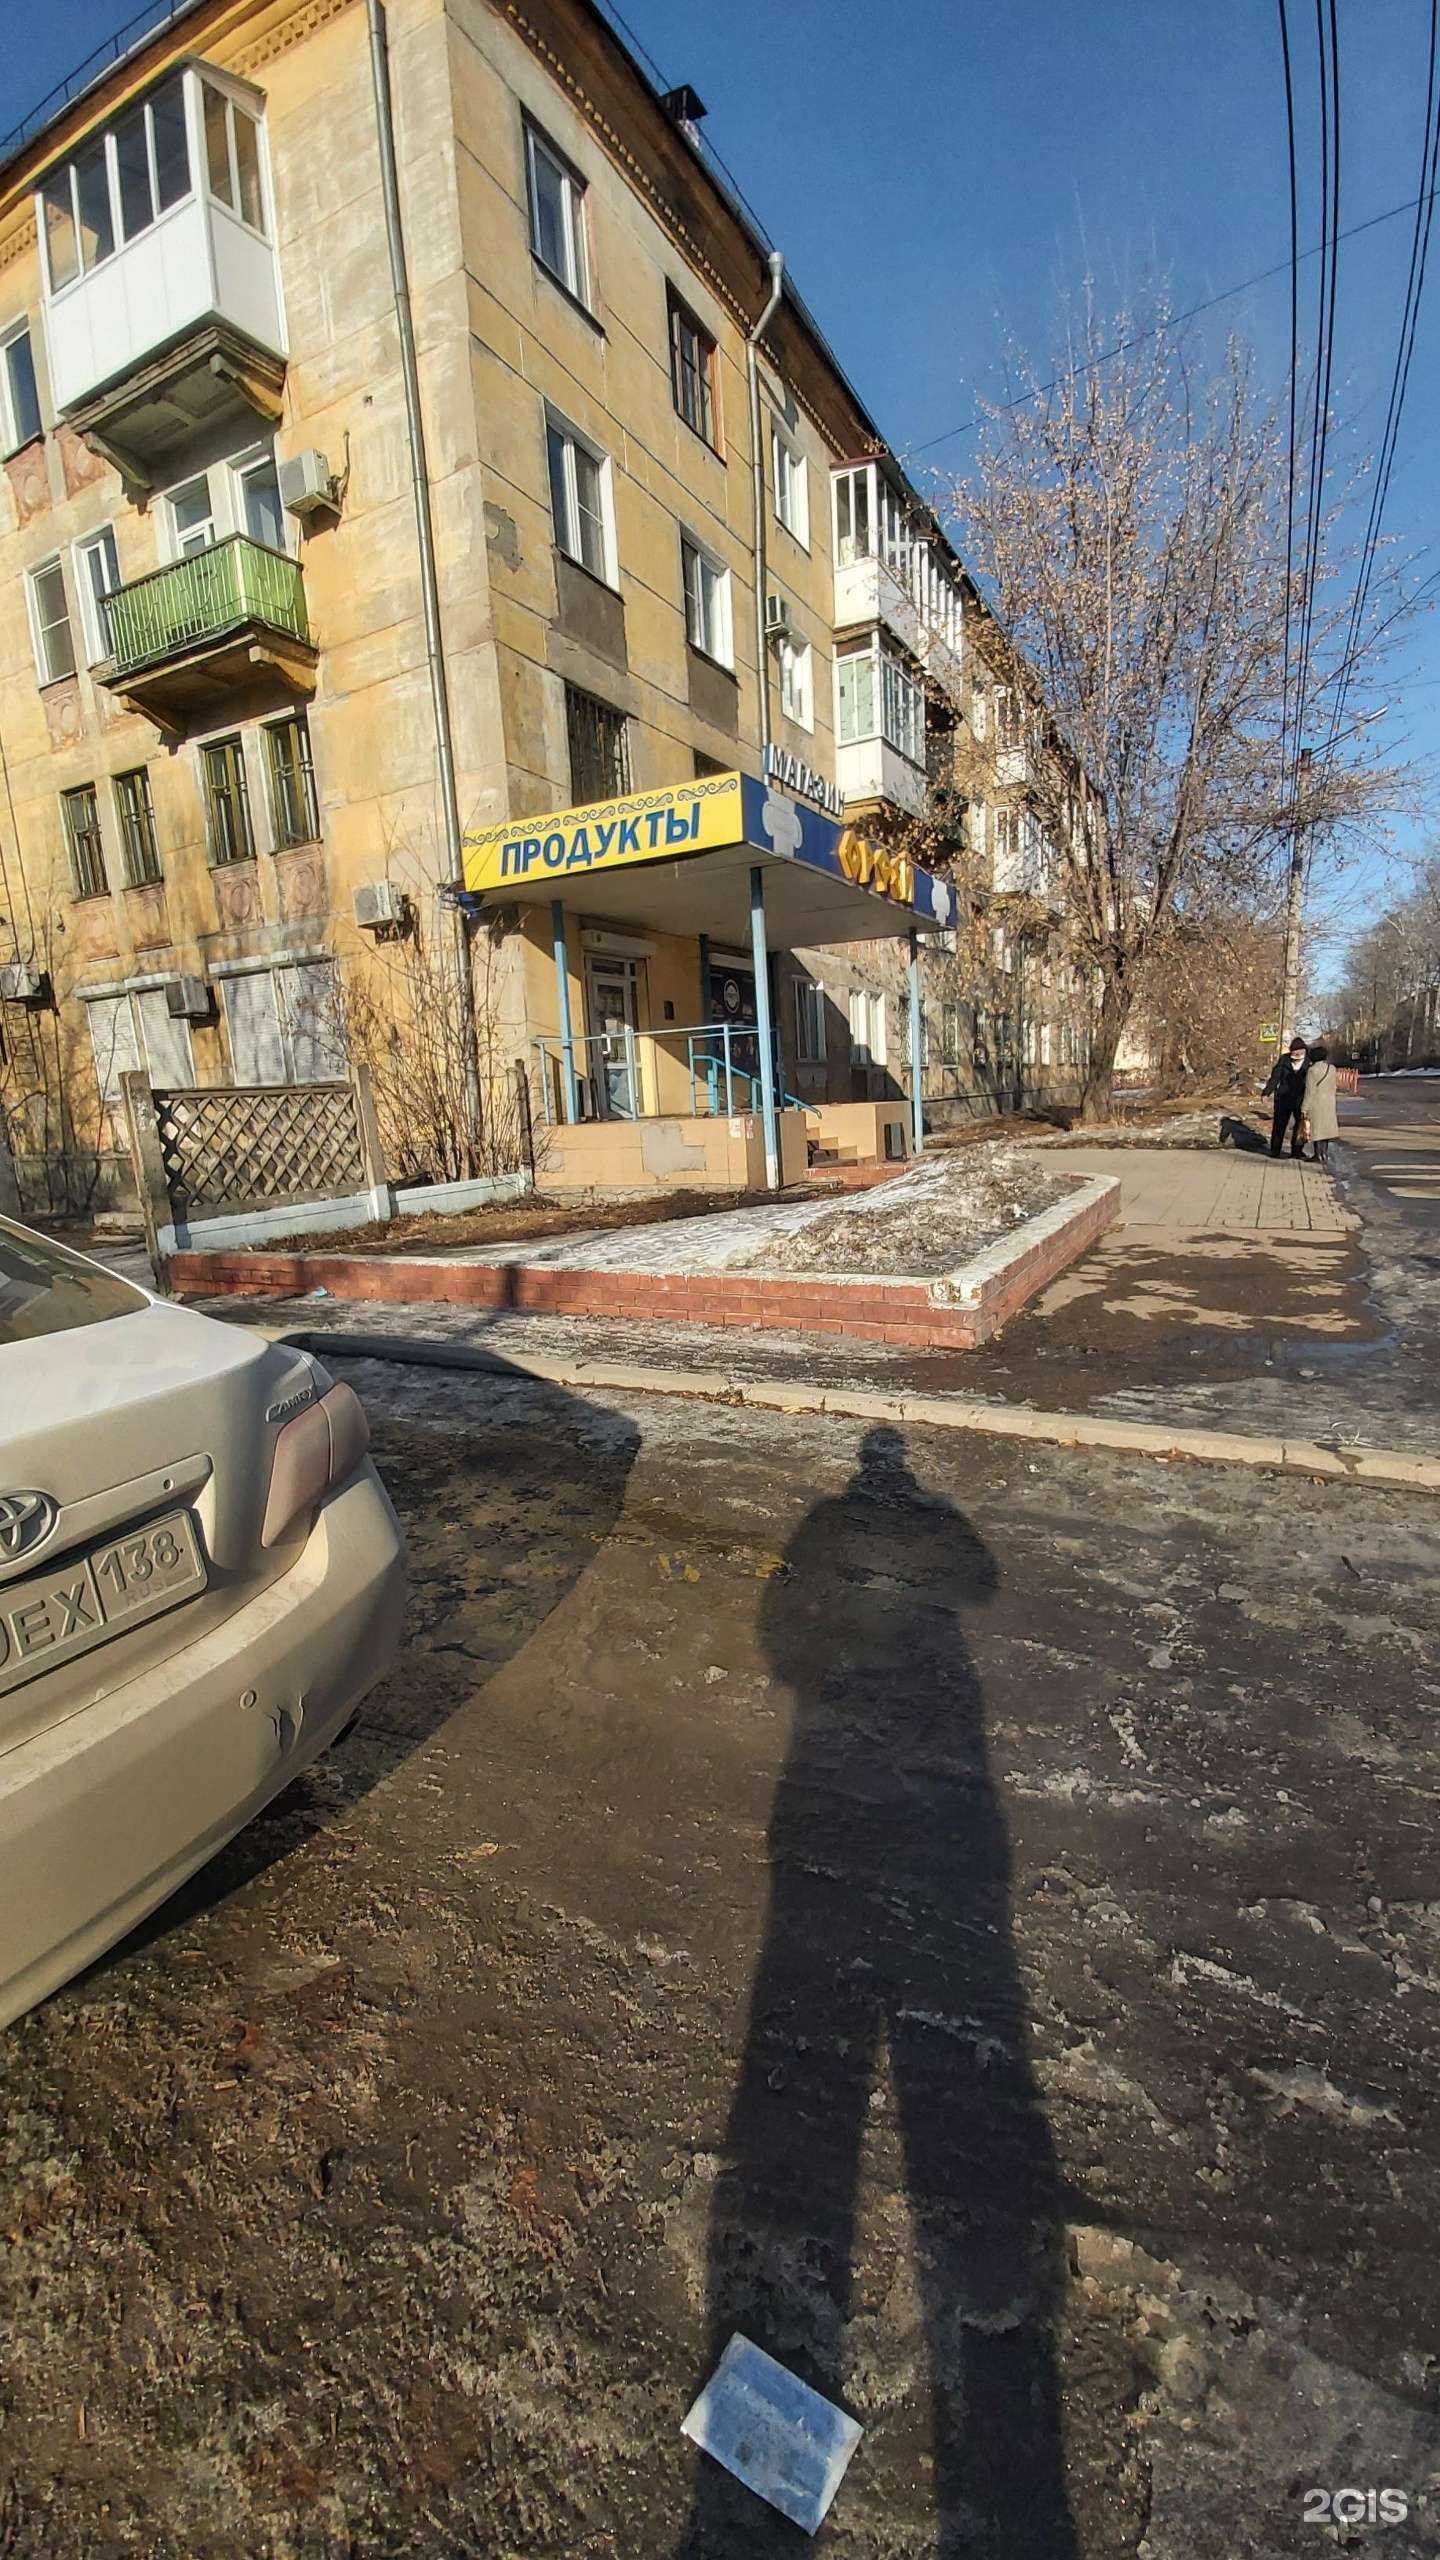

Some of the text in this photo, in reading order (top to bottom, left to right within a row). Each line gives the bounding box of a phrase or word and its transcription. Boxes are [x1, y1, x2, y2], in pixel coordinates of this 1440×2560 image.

[768, 743, 845, 817] МАГАЗИН
[500, 802, 701, 877] ПРОДУКТЫ
[97, 1529, 181, 1594] 138
